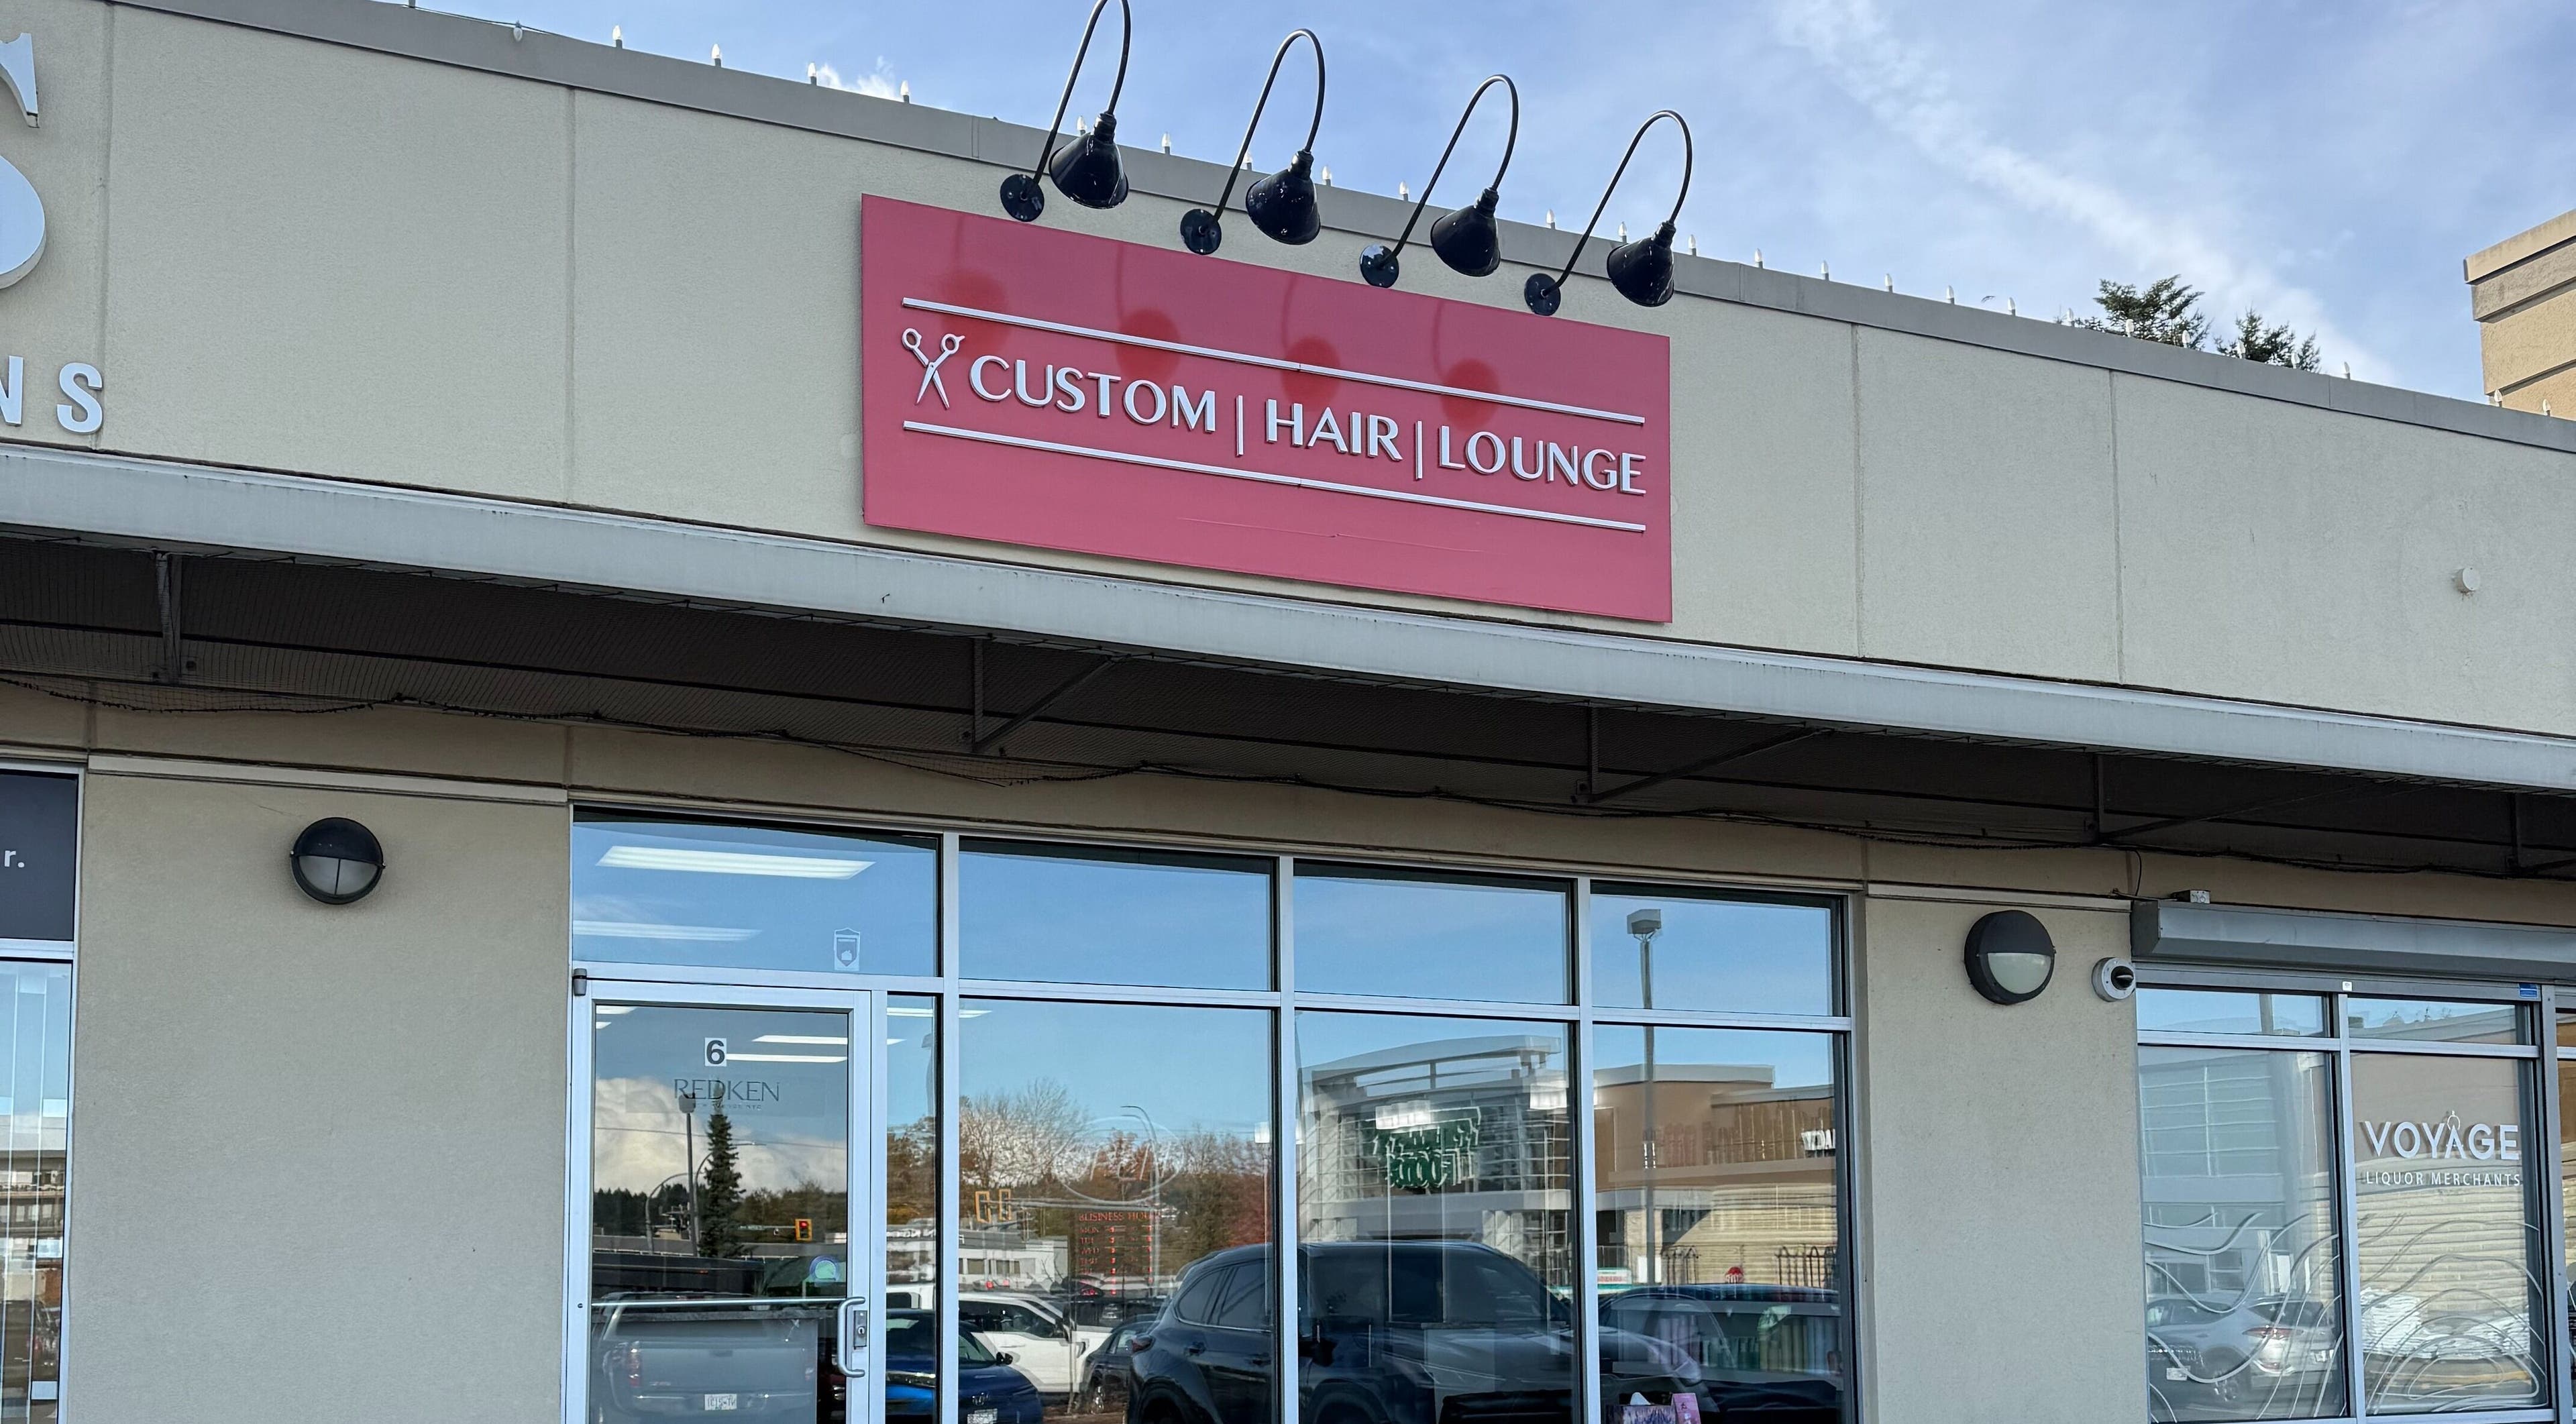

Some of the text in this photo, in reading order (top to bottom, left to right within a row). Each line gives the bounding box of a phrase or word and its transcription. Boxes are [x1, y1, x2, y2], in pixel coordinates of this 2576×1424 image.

[969, 355, 1216, 433] CUSTOM
[1265, 398, 1403, 461] HAIR
[1438, 425, 1647, 495] LOUNGE
[706, 1040, 725, 1064] 6
[674, 1079, 780, 1101] REDKEN
[2365, 1120, 2520, 1160] VOYAGE
[2365, 1171, 2520, 1187] LIQUOR MERCHANTS
[1079, 1211, 1124, 1221] BUSINESS
